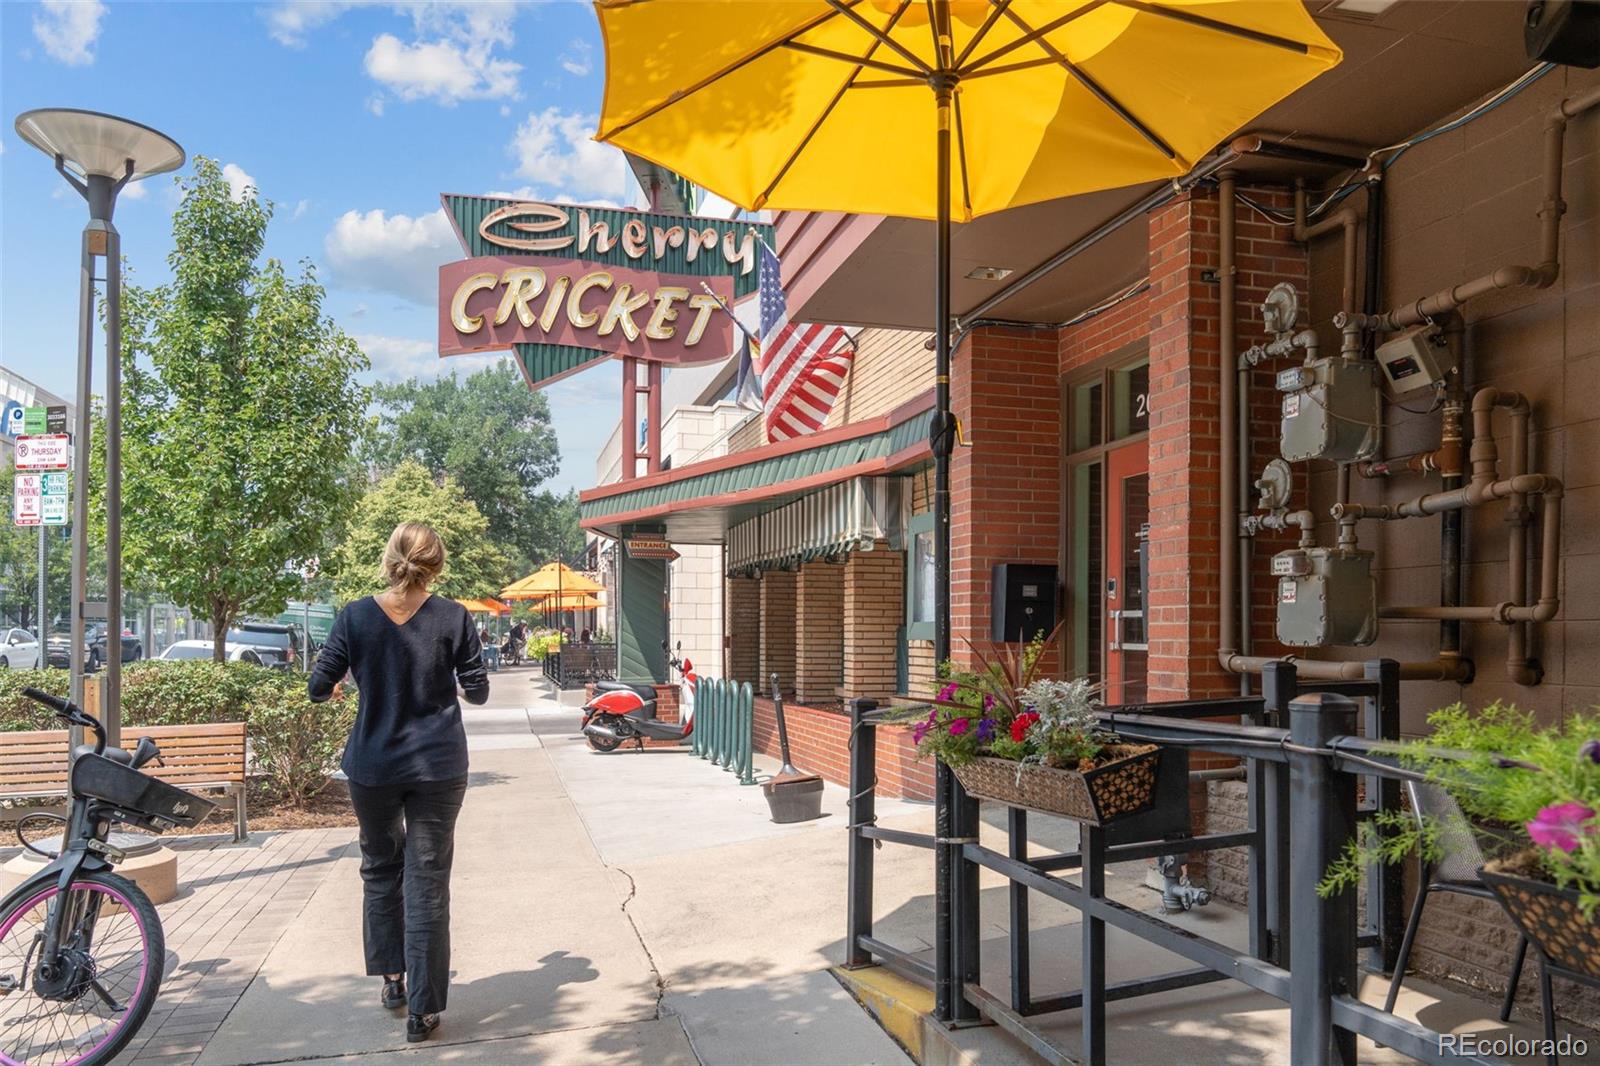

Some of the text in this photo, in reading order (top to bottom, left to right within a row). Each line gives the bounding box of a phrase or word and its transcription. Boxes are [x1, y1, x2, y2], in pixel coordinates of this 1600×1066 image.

[478, 201, 756, 277] Cherry
[450, 266, 728, 347] CRICKET
[24, 477, 33, 487] NO
[42, 477, 48, 492] 3
[48, 484, 66, 492] PARKING
[17, 487, 40, 496] PARKING
